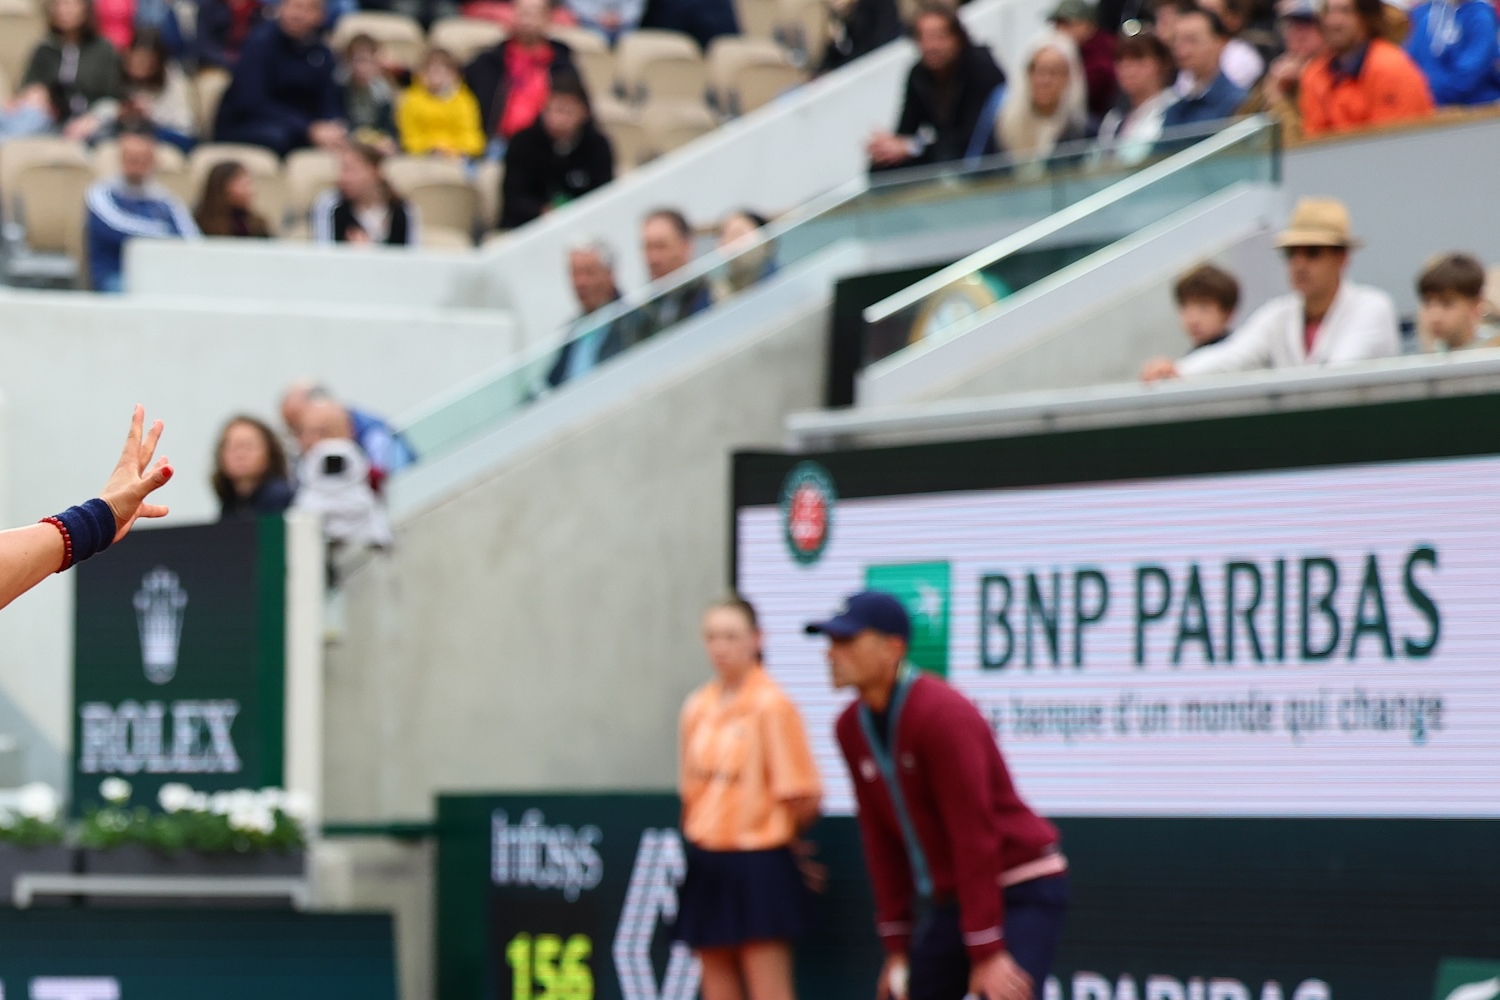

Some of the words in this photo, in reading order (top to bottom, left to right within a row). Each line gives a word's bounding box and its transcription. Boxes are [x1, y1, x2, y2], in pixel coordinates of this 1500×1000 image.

[979, 565, 1108, 672] BNP
[1134, 544, 1443, 667] PARIBAS
[79, 699, 241, 774] ROLEX
[1337, 687, 1444, 746] change
